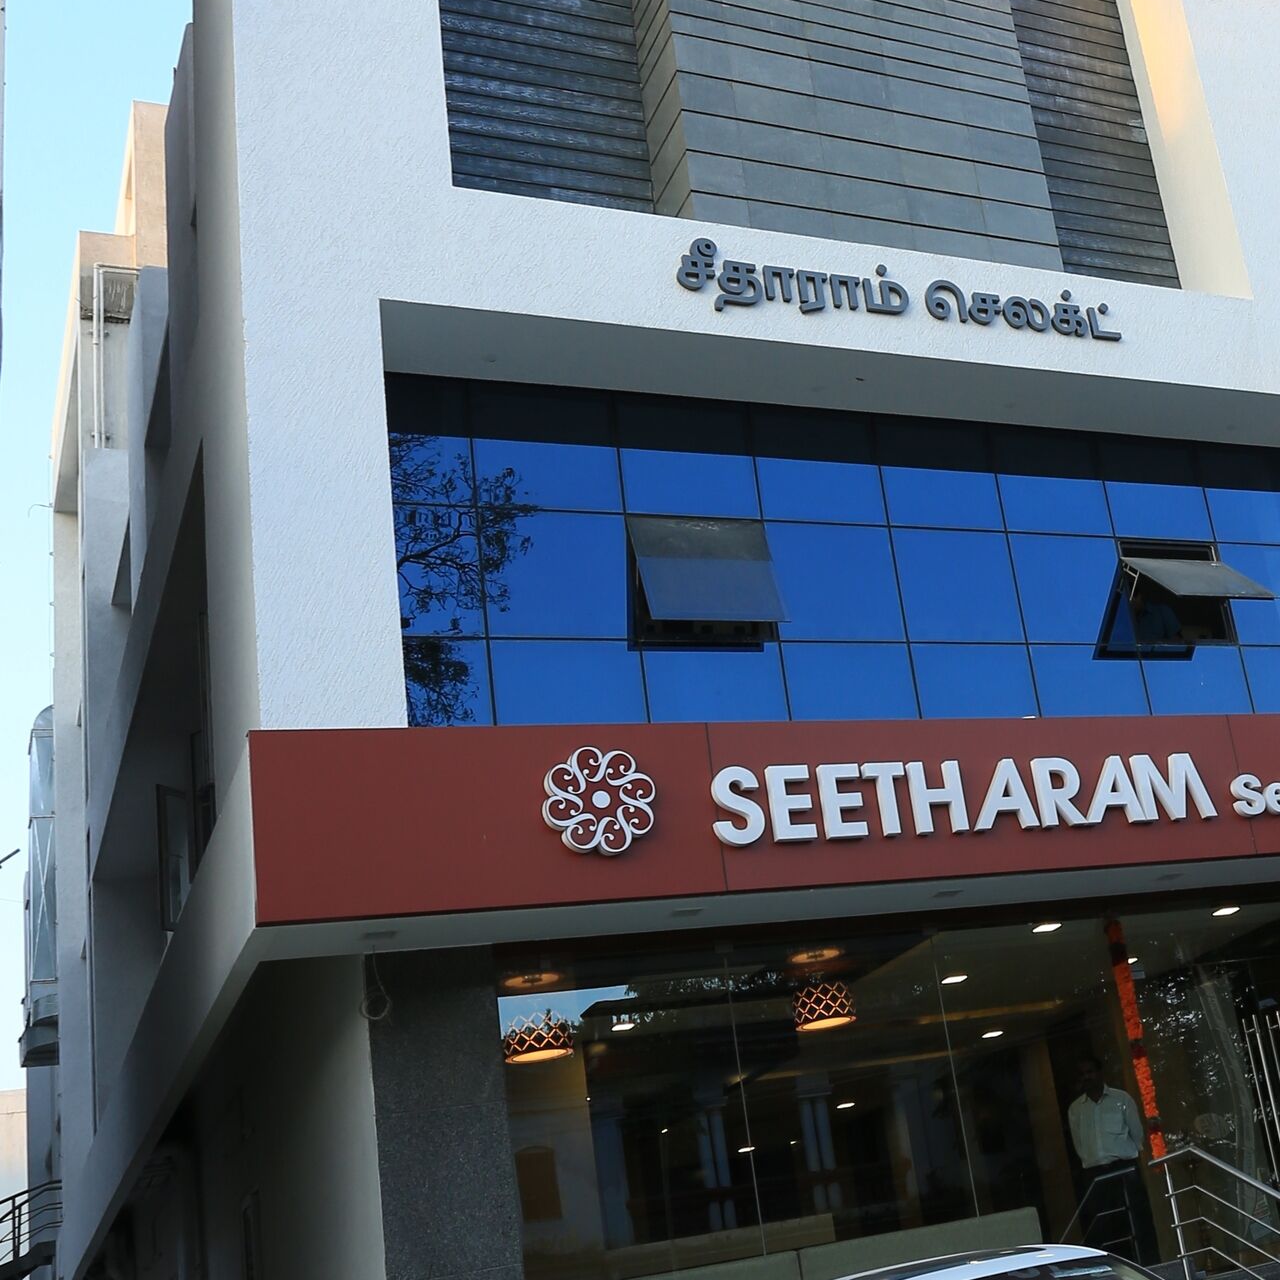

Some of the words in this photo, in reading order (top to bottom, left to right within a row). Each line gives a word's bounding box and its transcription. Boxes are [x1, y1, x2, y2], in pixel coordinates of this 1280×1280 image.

[676, 237, 909, 315] சீதாராம்
[924, 278, 1122, 342] செலக்ட்
[711, 752, 1218, 847] SEETHARAM
